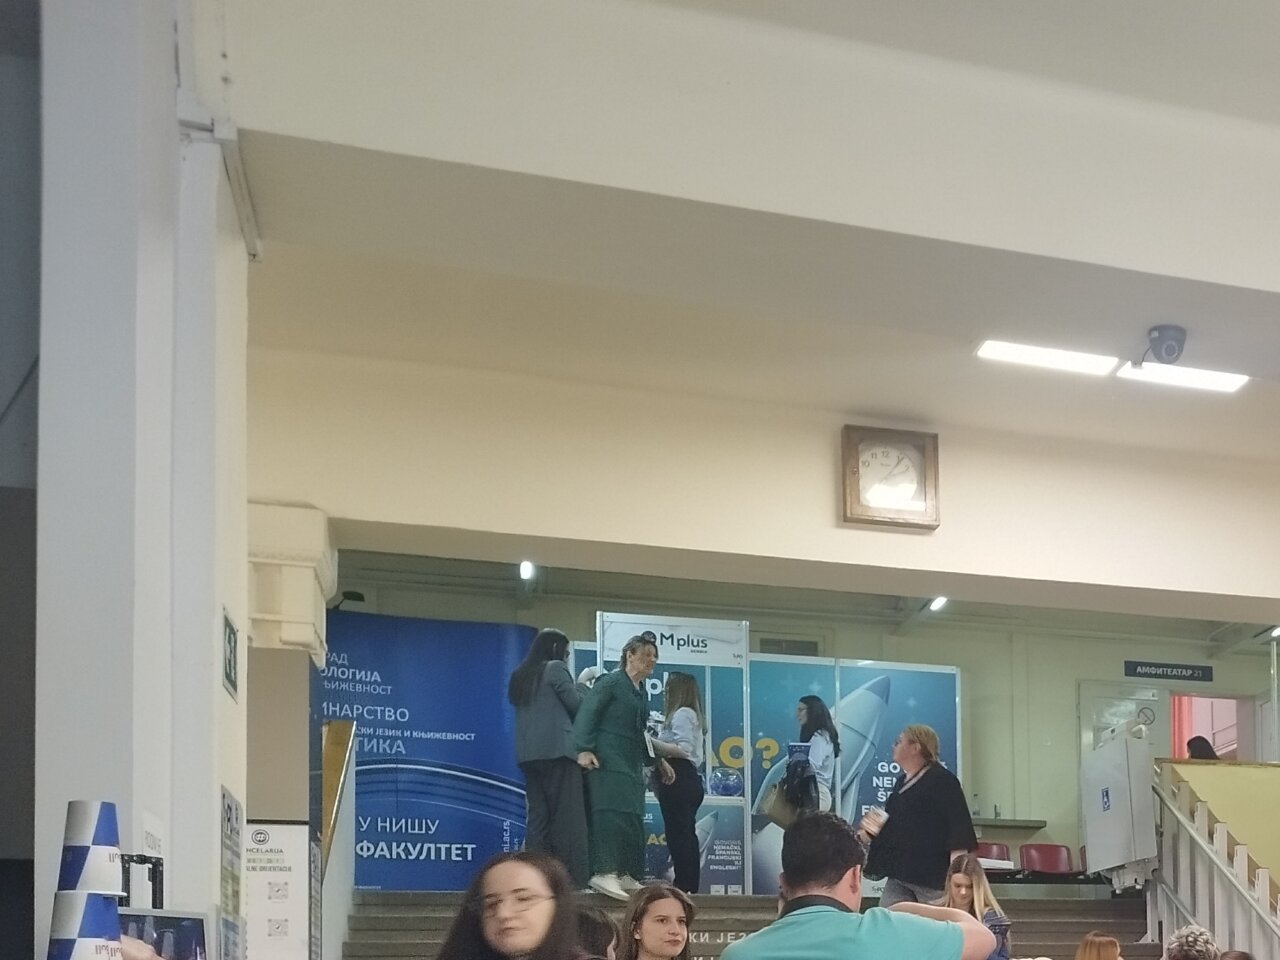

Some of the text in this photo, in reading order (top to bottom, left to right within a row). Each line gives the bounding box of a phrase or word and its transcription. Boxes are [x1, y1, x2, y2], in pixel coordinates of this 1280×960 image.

[320, 666, 381, 683] ОЛОГИЈА
[1136, 665, 1192, 676] АМФИТЕАТАР
[355, 737, 406, 755] ТИКА
[359, 816, 440, 834] У НИШУ
[502, 820, 511, 853] ni.ac.rs
[356, 840, 477, 861] ФАКУЛТЕТ
